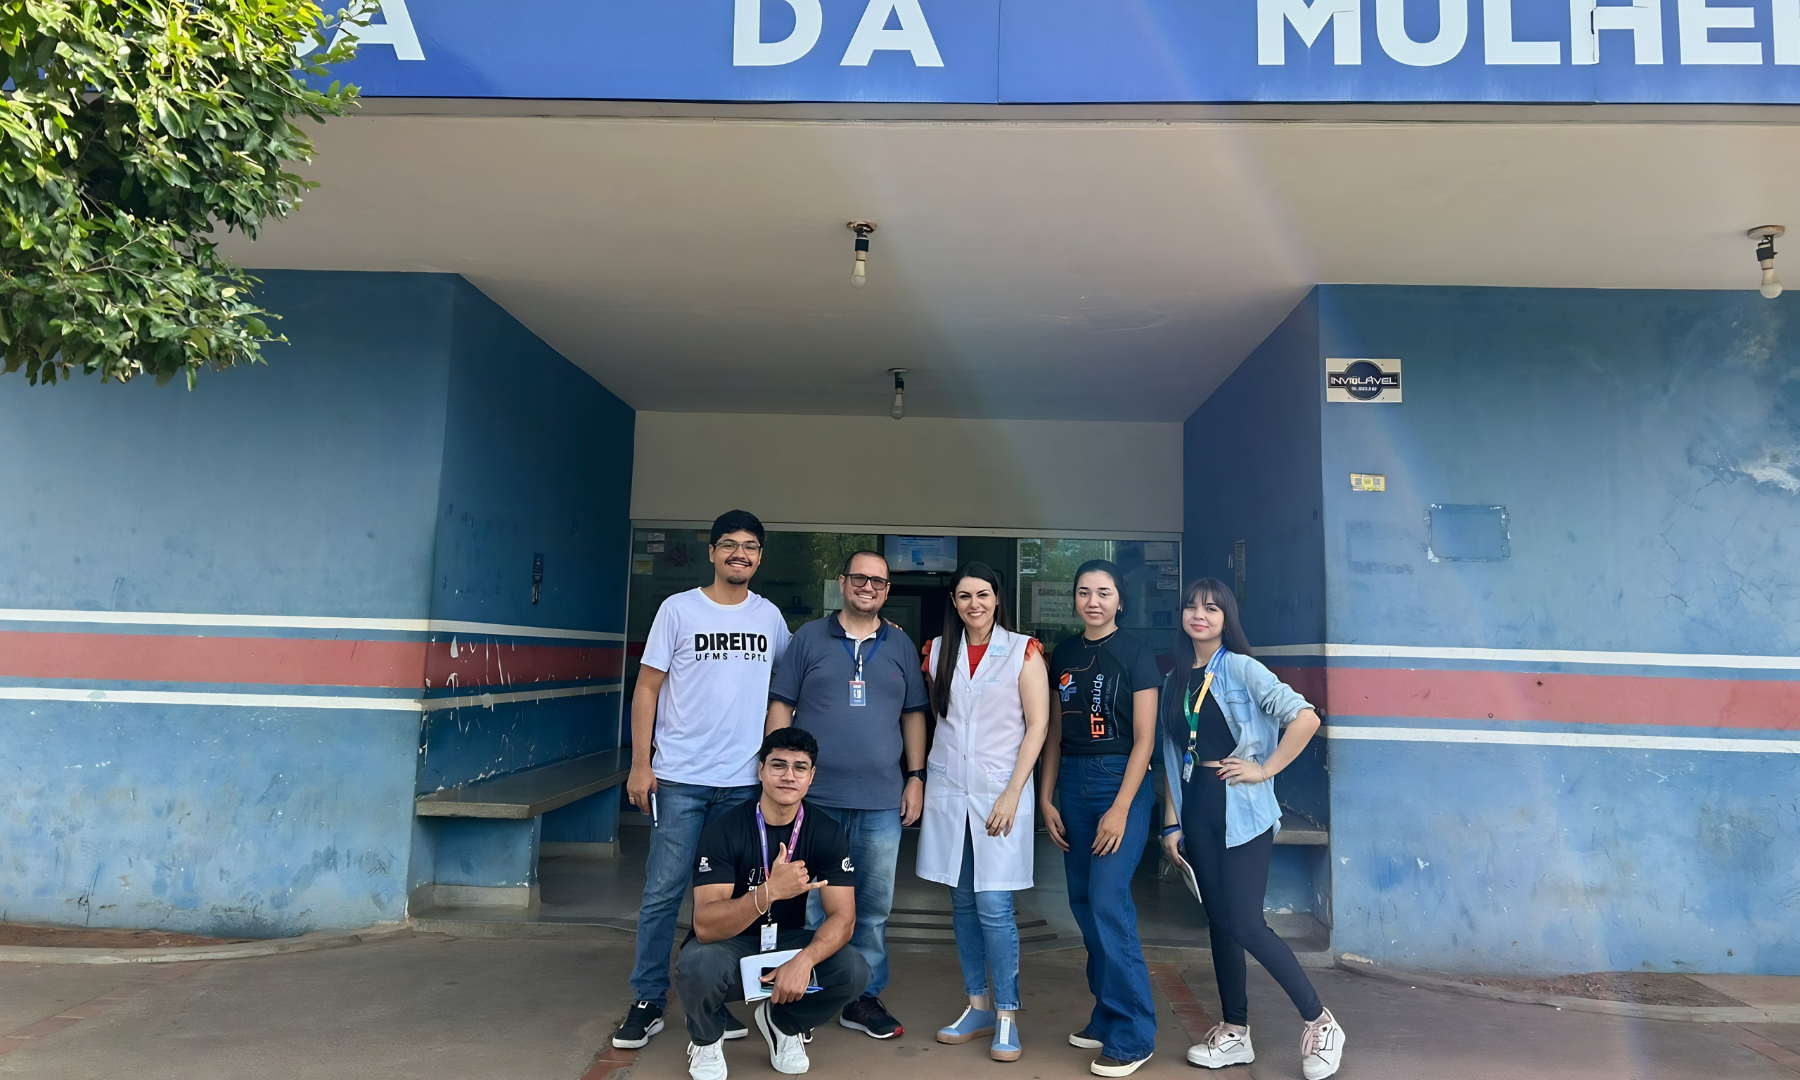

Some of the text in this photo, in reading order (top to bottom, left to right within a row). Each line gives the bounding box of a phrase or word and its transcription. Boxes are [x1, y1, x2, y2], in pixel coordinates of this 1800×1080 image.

[733, 0, 945, 67] DA
[1258, 0, 1800, 66] MULHE
[694, 632, 768, 653] DIREITO
[695, 652, 728, 662] UFMS
[744, 652, 767, 662] CPTL
